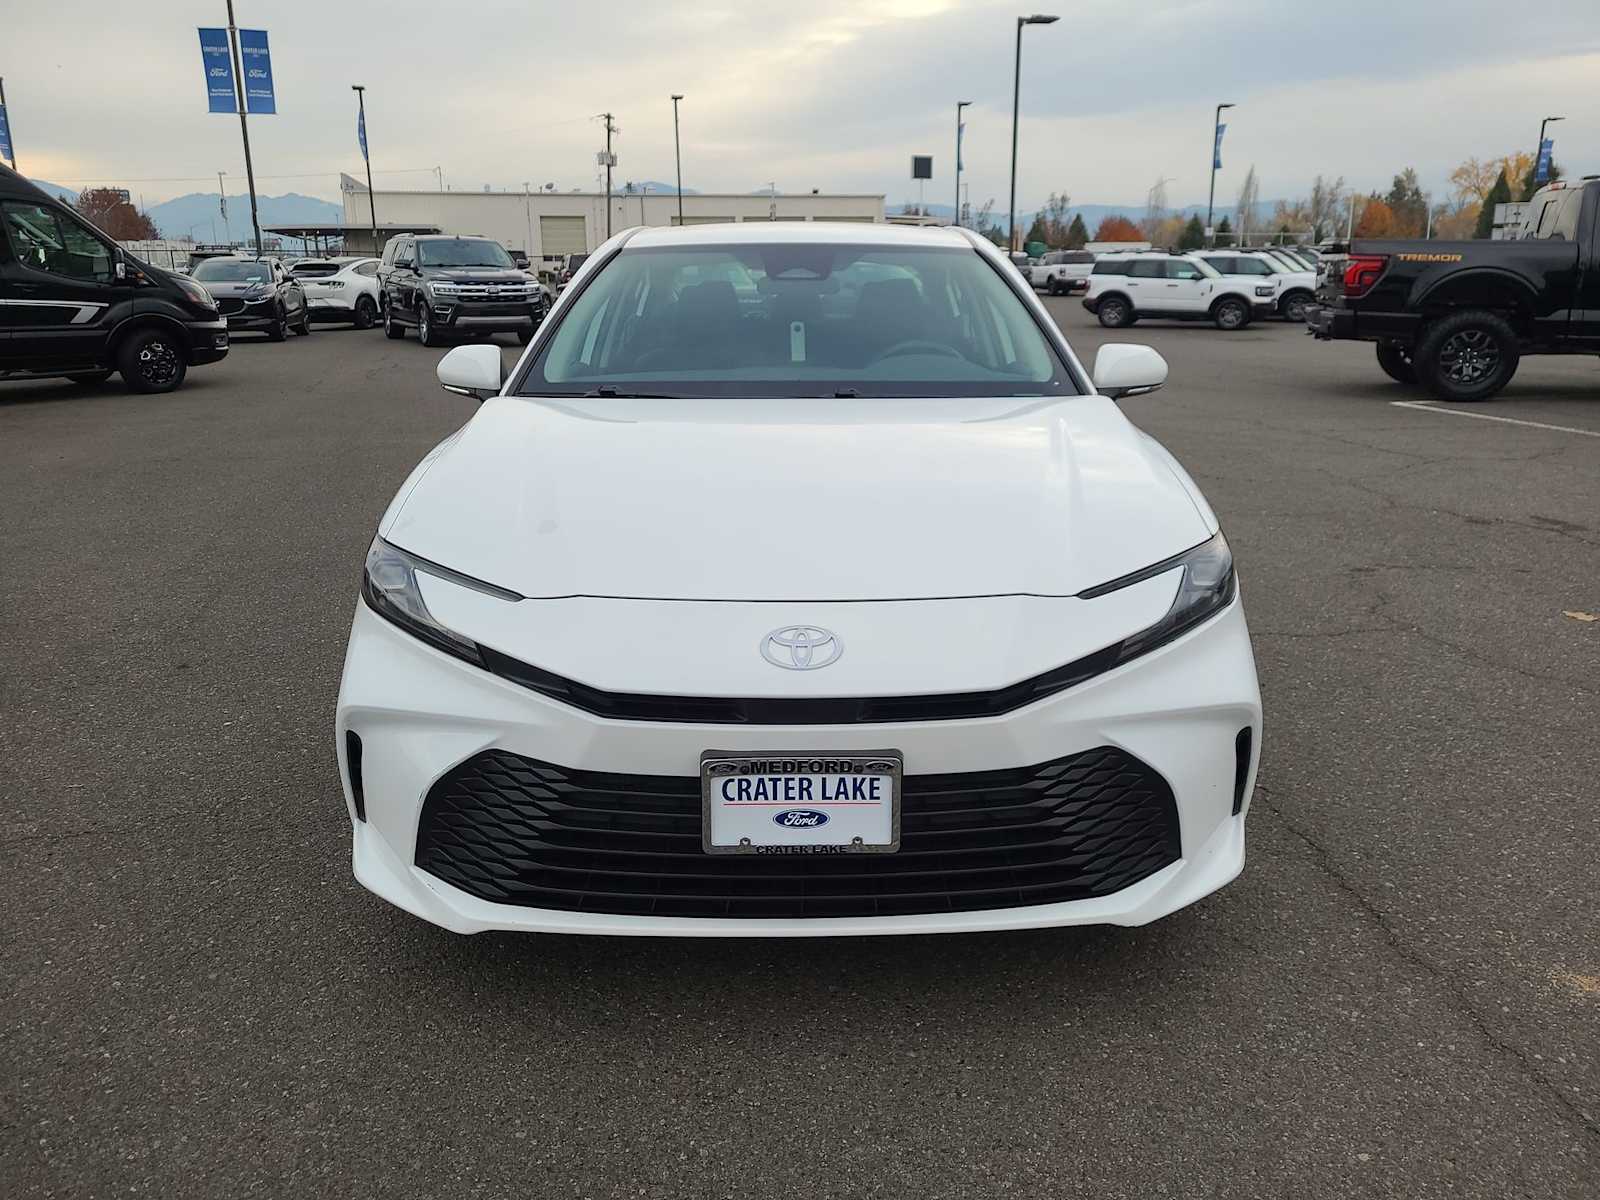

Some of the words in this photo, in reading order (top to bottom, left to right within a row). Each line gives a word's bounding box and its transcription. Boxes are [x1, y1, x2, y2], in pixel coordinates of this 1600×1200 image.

[210, 67, 228, 77] Ford
[248, 69, 267, 78] Ford
[1397, 253, 1462, 262] TREMOR
[750, 760, 853, 774] MEDFORD
[721, 777, 813, 802] CRATER
[821, 777, 881, 801] LAKE
[784, 811, 819, 826] Ford
[756, 845, 809, 855] CRATER
[813, 845, 848, 855] LAKE
